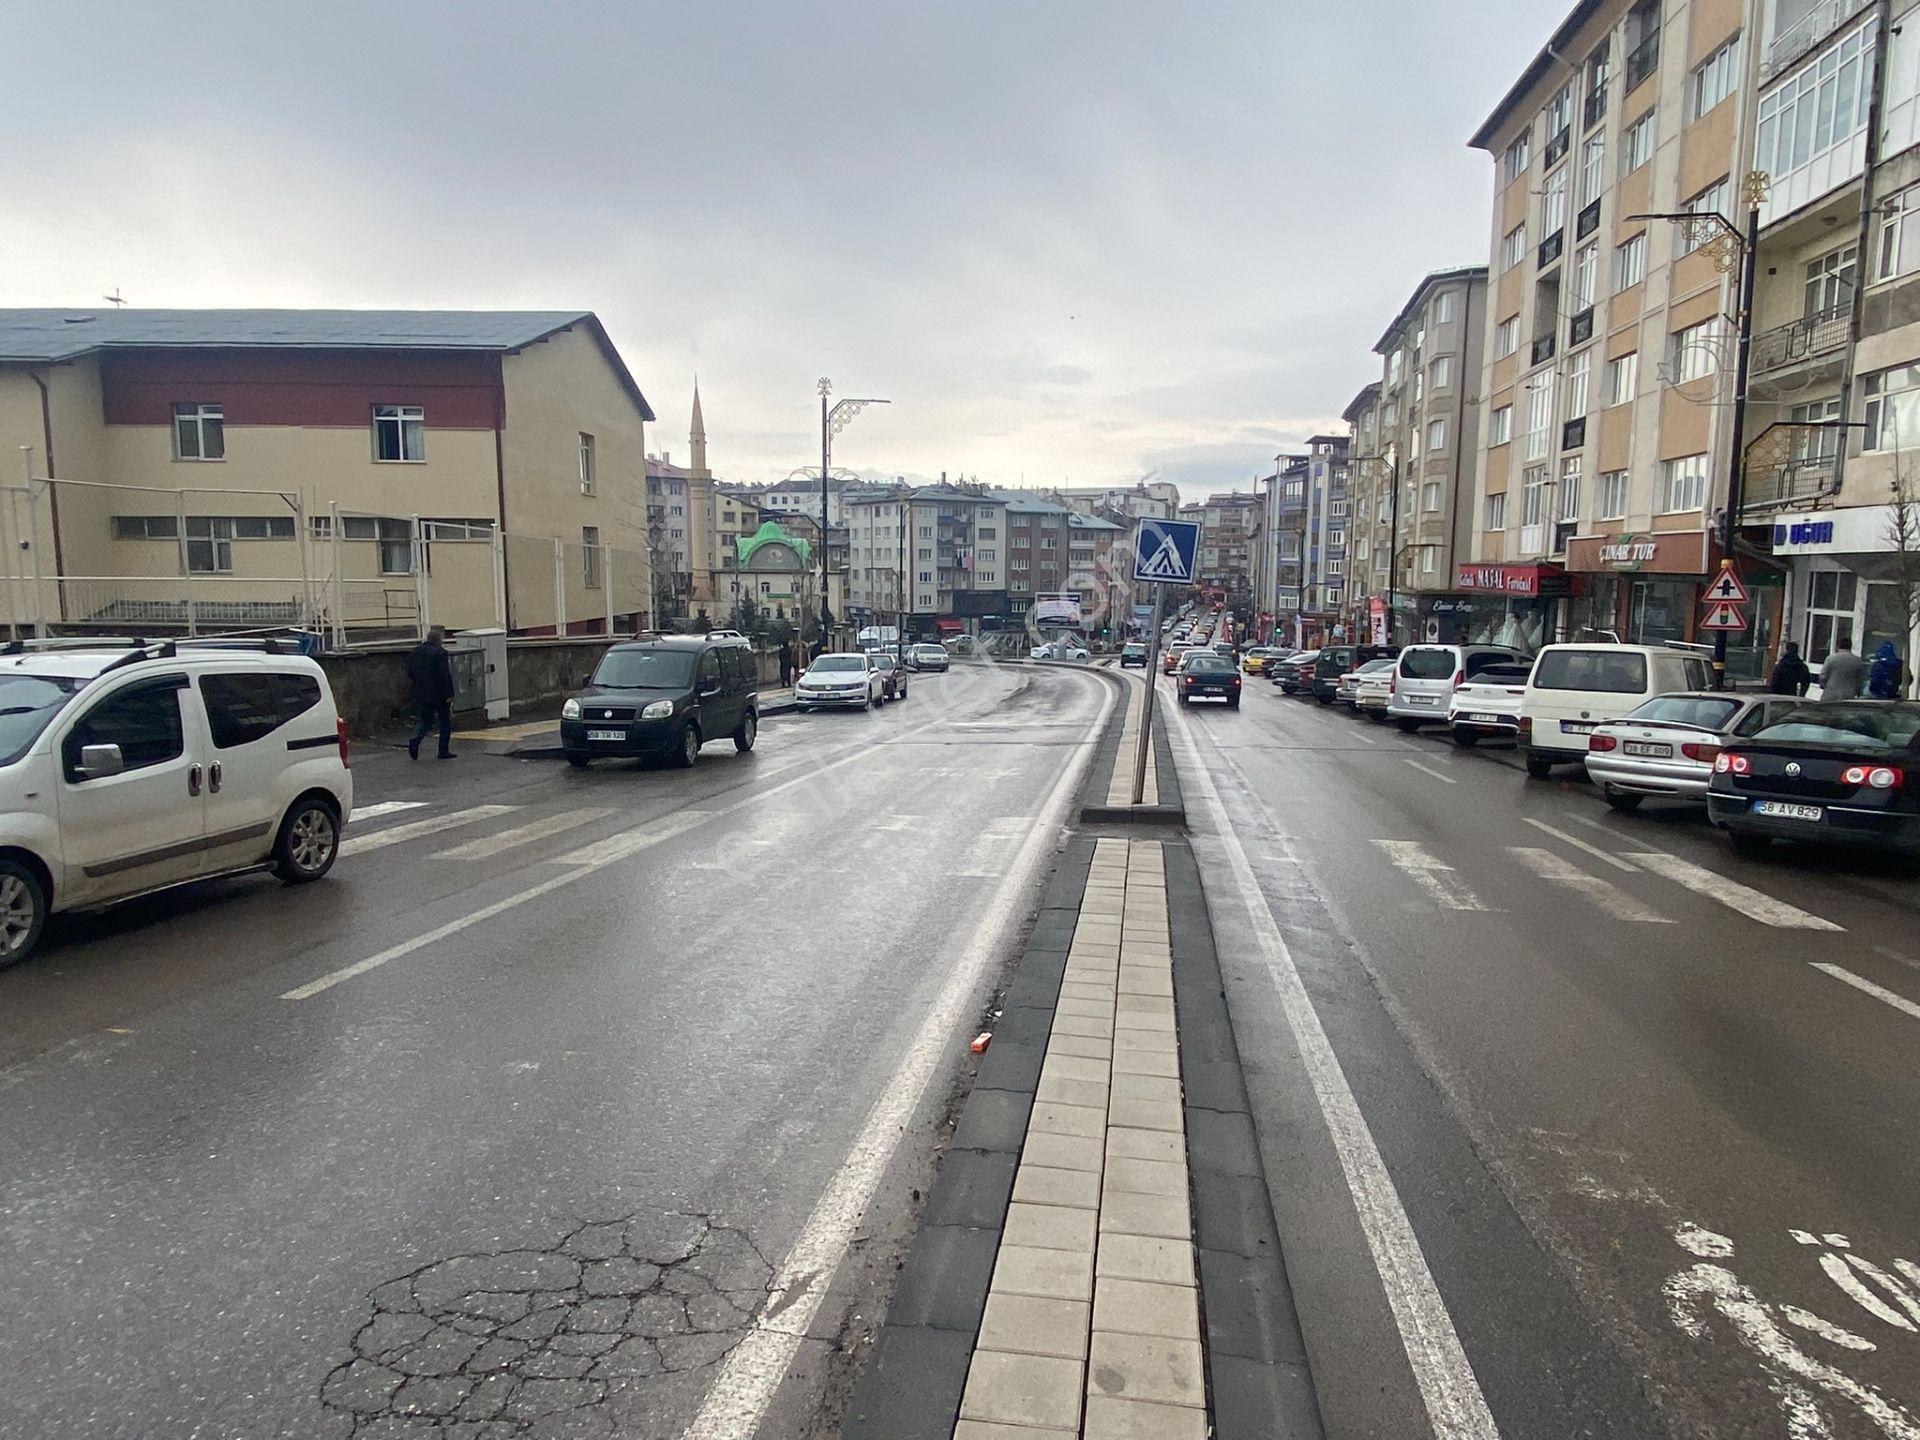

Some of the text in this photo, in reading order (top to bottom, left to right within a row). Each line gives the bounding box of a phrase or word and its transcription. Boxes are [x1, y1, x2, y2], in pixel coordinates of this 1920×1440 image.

[1599, 543, 1656, 563] ÇINAR TUR
[1477, 569, 1504, 588] MASAL
[1640, 745, 1652, 754] EF
[1779, 804, 1795, 815] AV
[1797, 806, 1819, 817] 829
